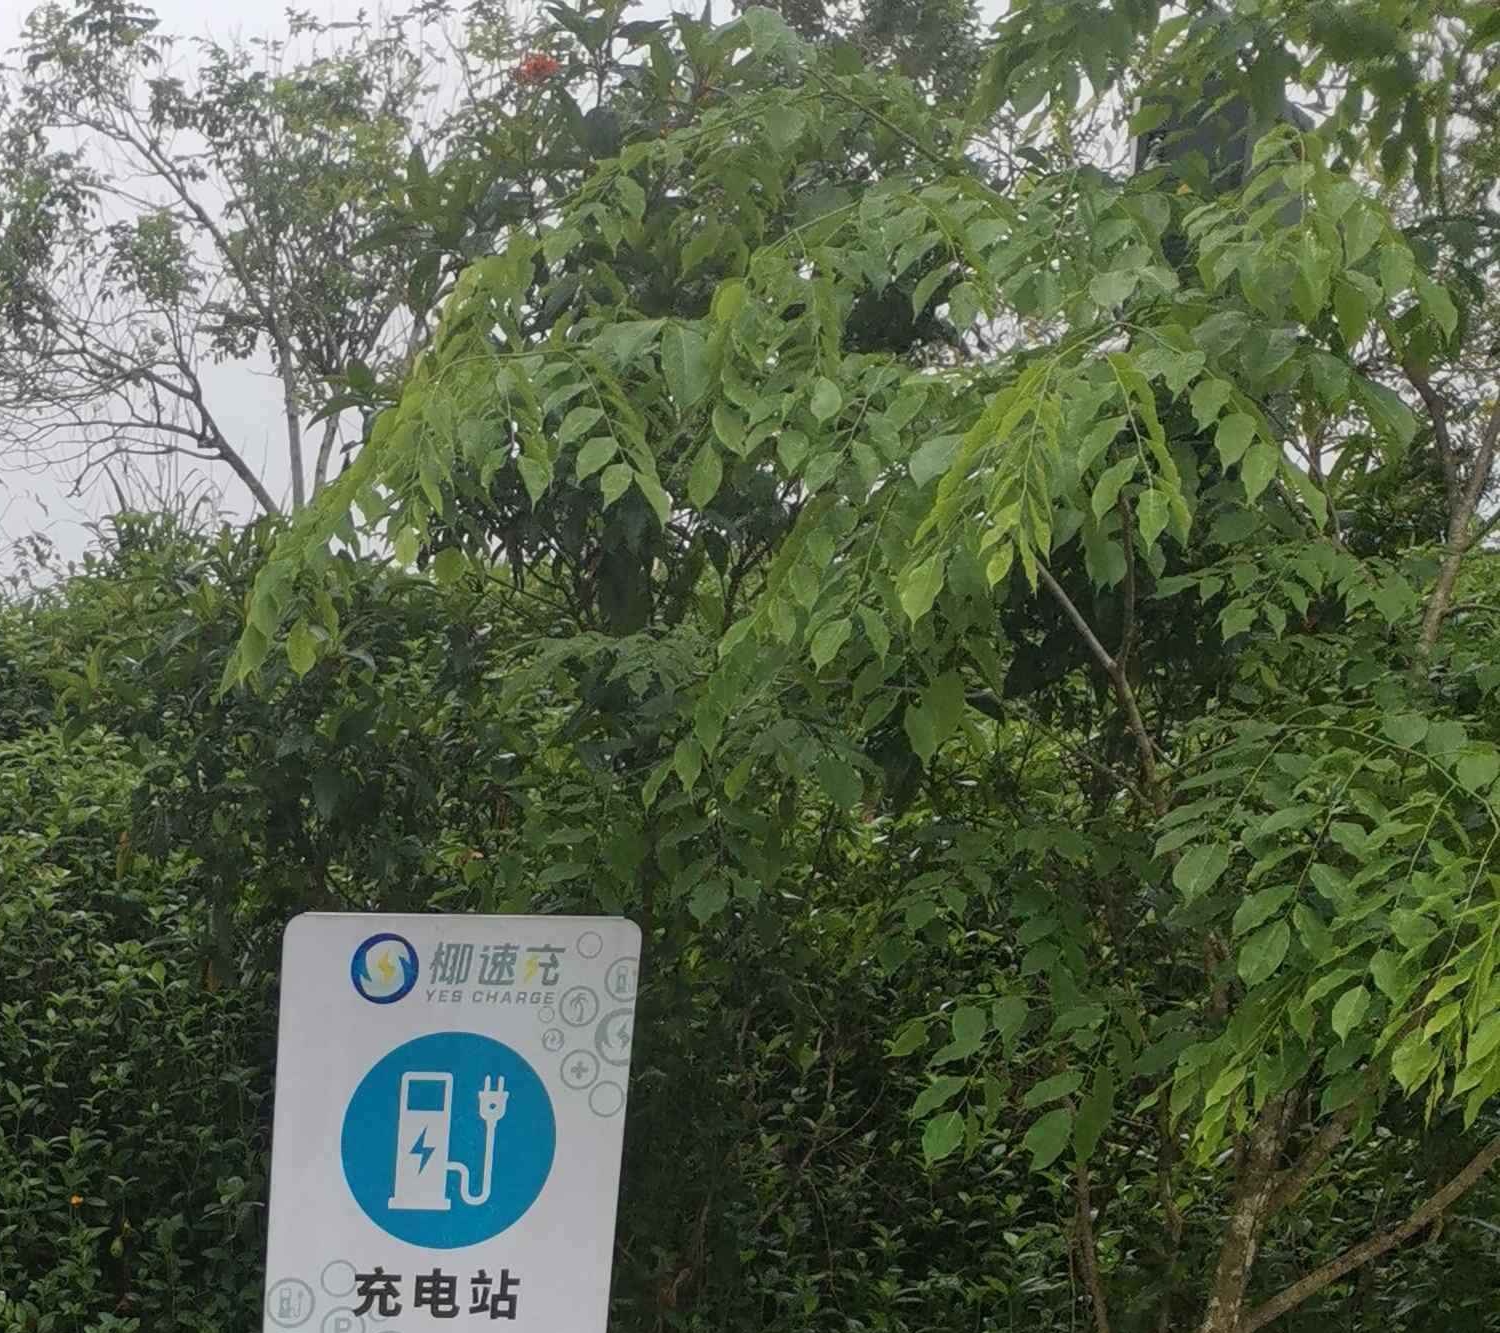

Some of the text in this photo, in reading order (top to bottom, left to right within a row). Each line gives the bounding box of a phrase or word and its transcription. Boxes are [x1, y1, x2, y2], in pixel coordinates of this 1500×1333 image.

[425, 989, 555, 1005] YES CHARGE
[352, 1266, 521, 1320] 充电站
